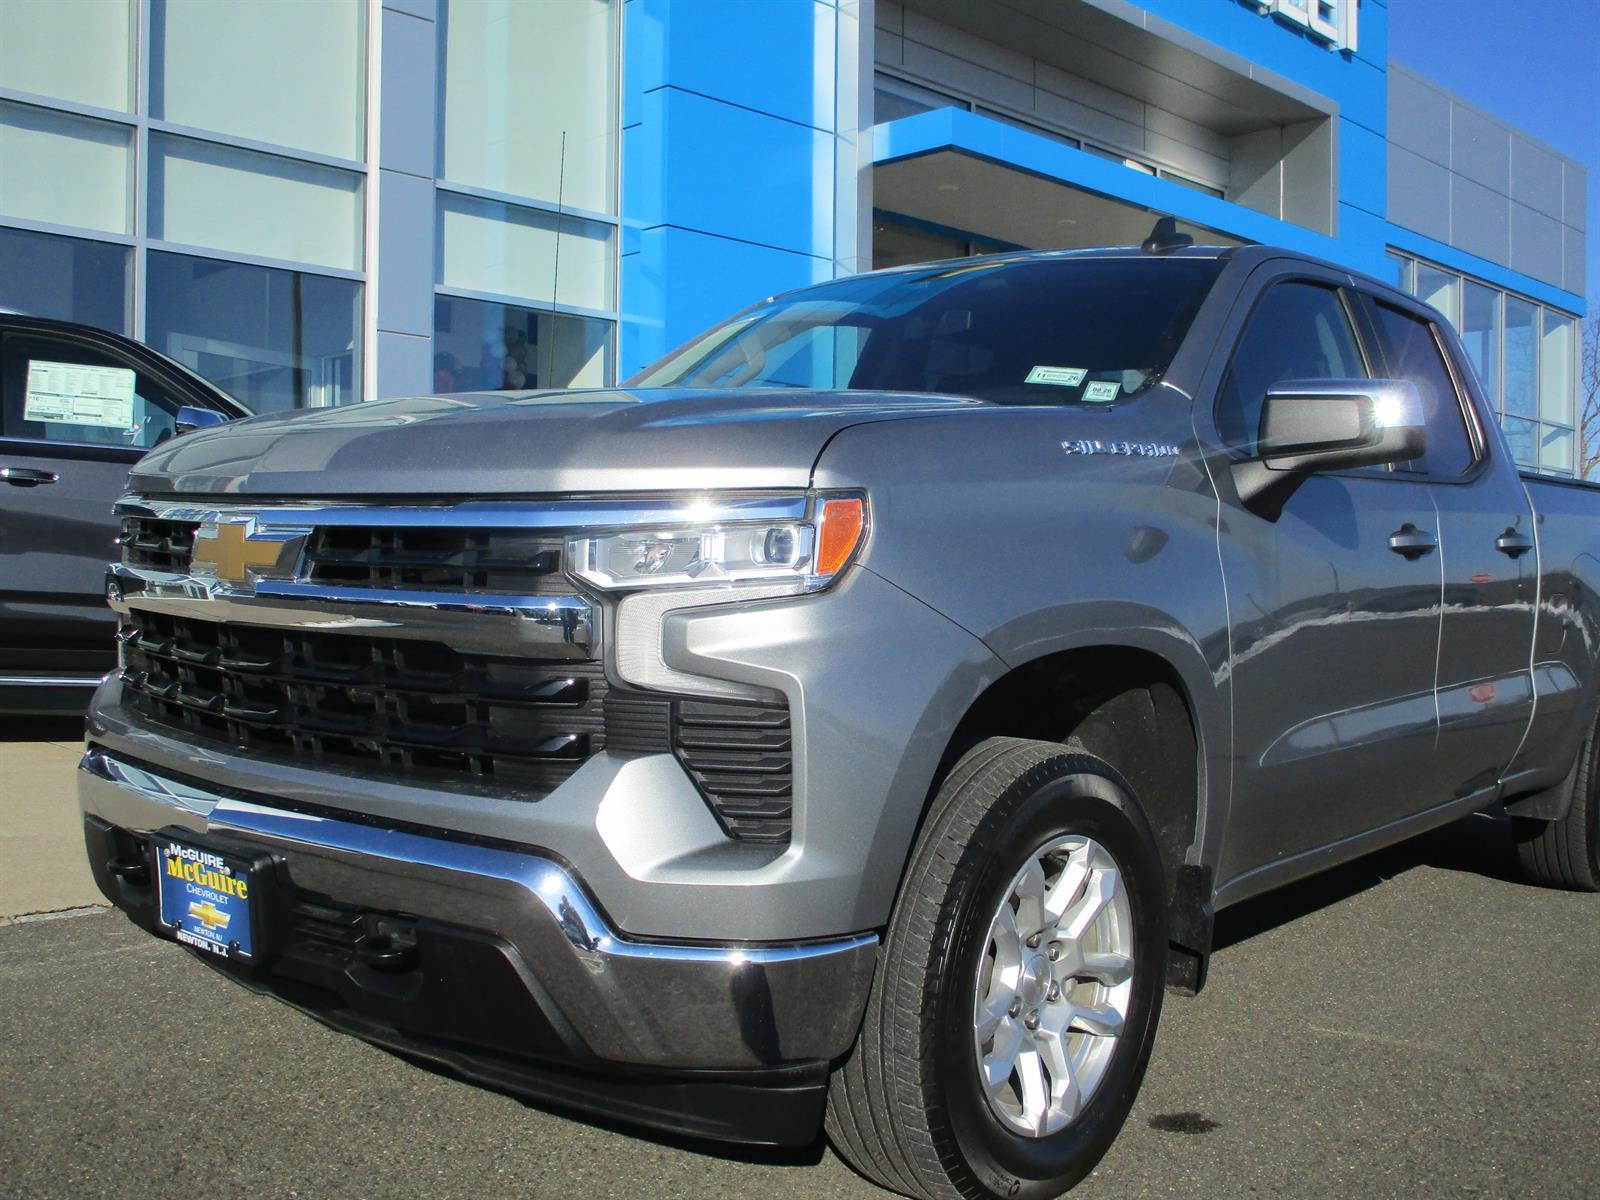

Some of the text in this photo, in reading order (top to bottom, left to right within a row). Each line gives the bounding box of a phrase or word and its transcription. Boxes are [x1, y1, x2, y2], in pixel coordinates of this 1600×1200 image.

[170, 843, 224, 869] McGUIRE
[167, 856, 248, 899] McGuire
[186, 883, 229, 904] CHEVROLET
